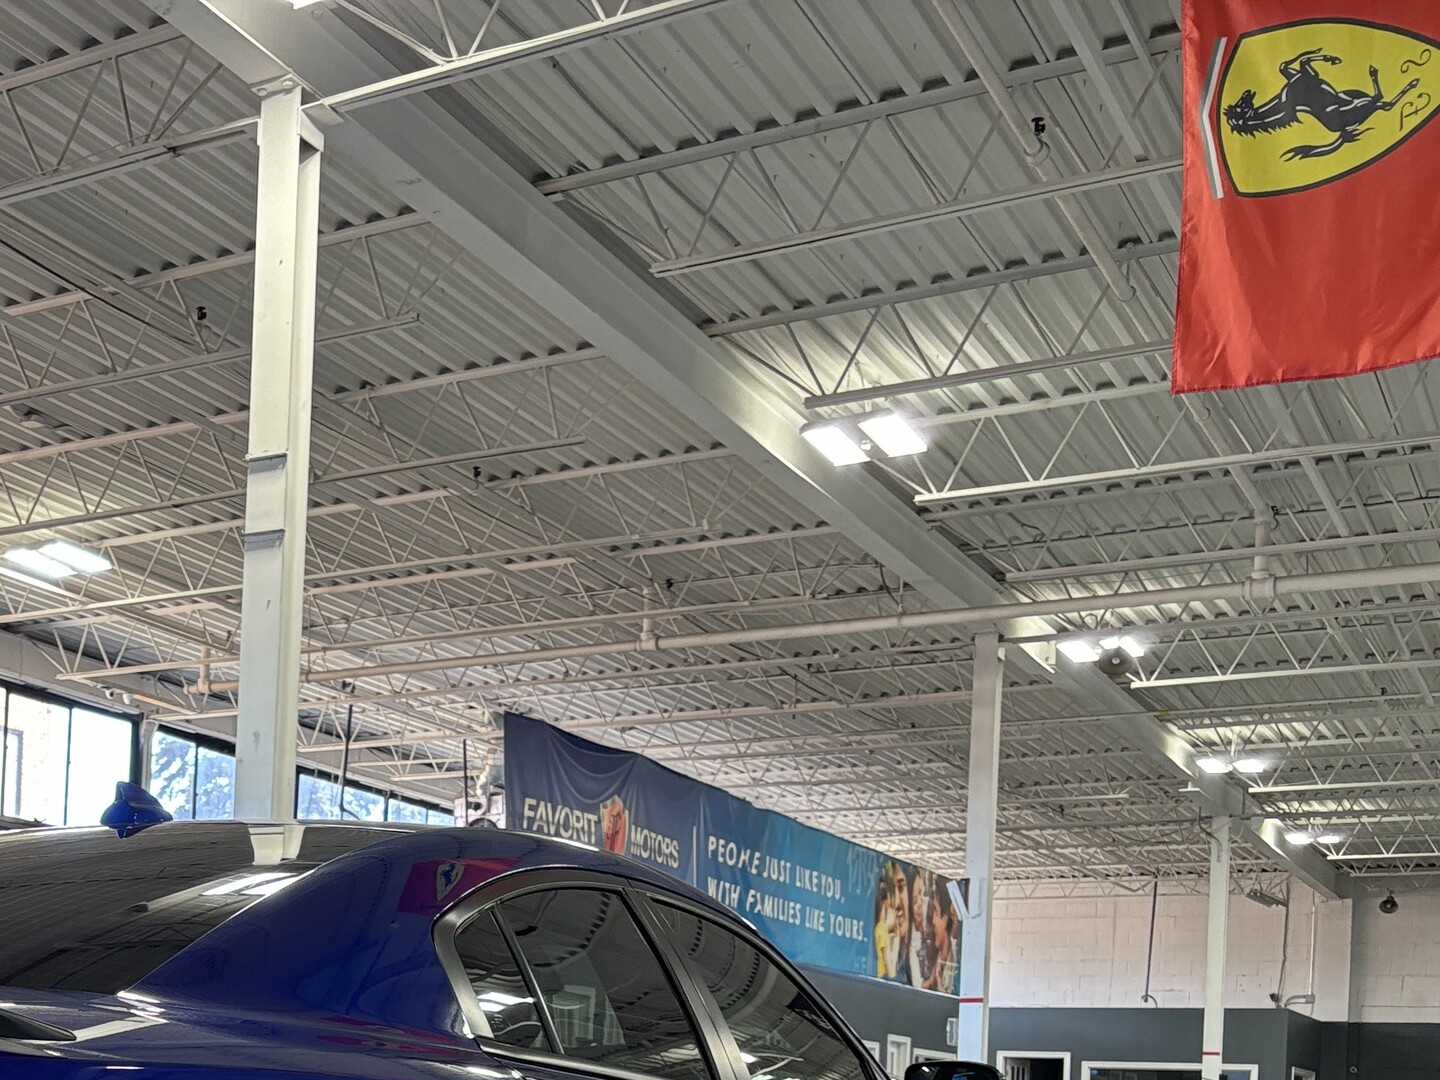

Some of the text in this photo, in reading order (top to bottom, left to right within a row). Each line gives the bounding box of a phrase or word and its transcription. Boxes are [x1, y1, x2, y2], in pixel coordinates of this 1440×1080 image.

[522, 797, 599, 846] FAVORIT
[630, 824, 680, 869] MOTORS
[763, 855, 791, 884] JUST
[795, 865, 819, 893] LIKE
[706, 875, 869, 943] WITH FAMILIES LIKE YOURS.
